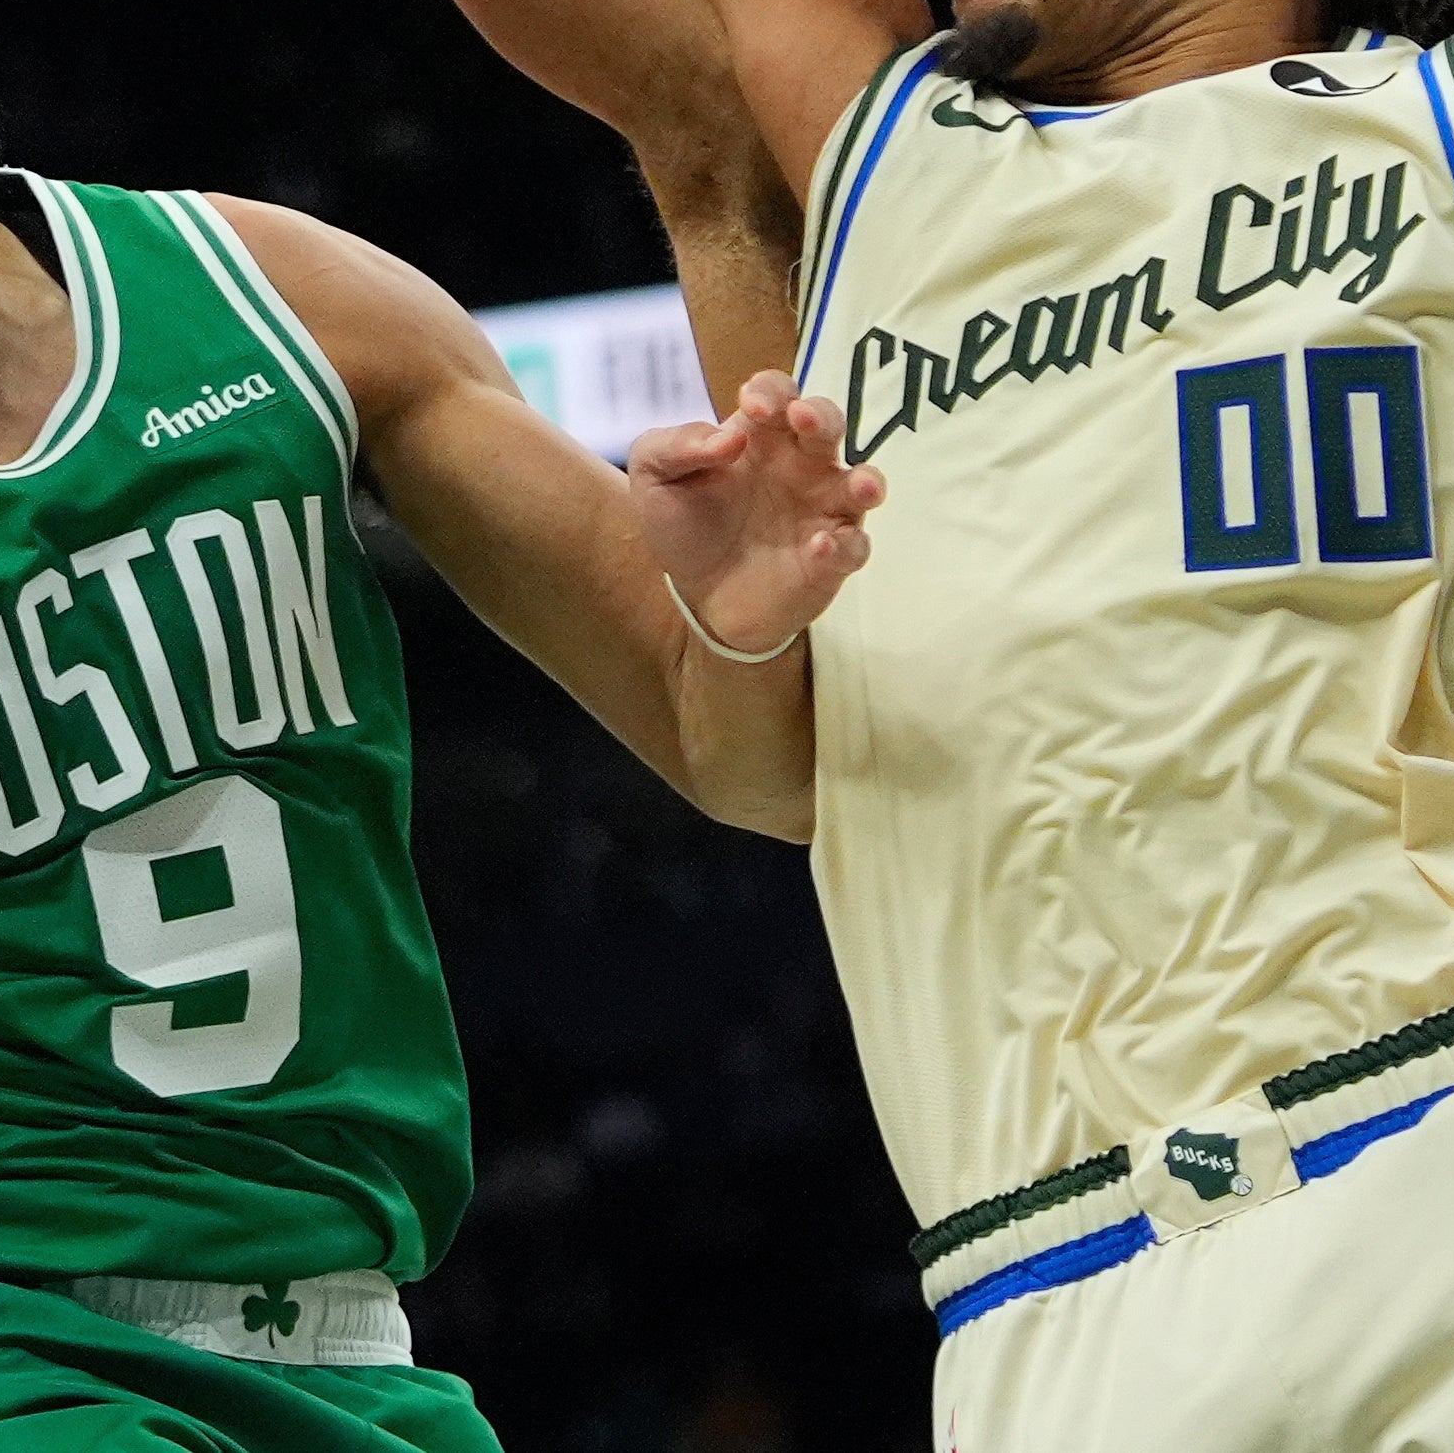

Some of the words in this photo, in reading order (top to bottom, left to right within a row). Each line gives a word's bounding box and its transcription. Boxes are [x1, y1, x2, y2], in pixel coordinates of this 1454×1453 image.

[141, 373, 276, 448] Amica
[846, 256, 1174, 466] Cream
[1196, 154, 1426, 304] City
[1176, 345, 1433, 573] 00
[81, 774, 303, 1099] 9
[1171, 1144, 1236, 1174] BUCKS
